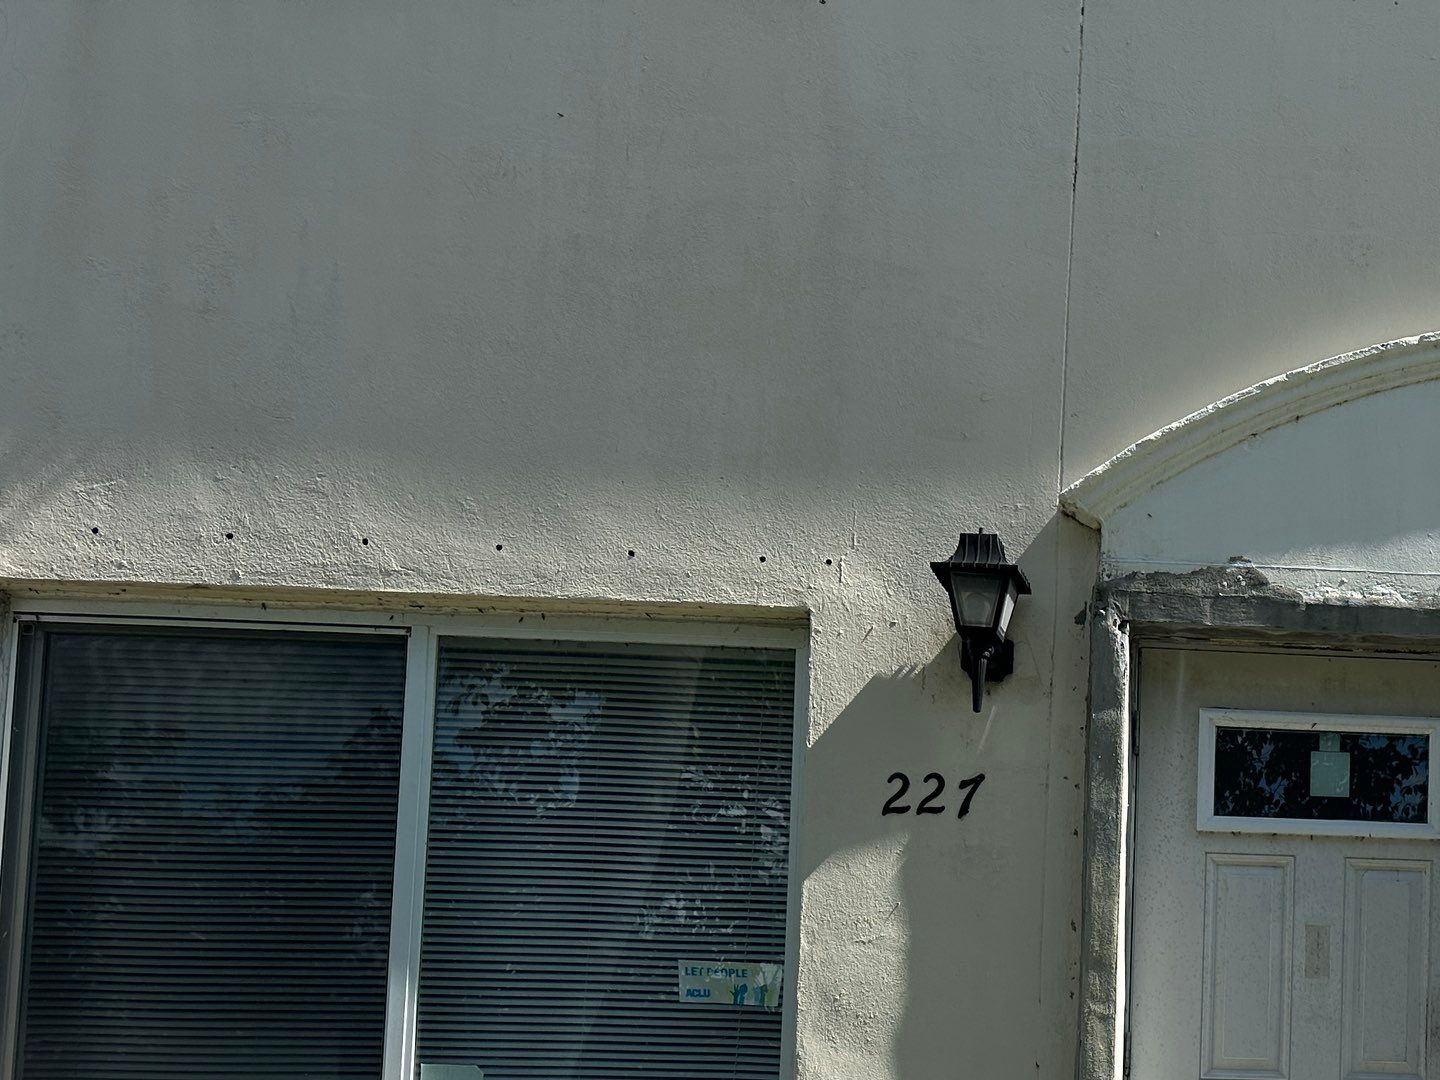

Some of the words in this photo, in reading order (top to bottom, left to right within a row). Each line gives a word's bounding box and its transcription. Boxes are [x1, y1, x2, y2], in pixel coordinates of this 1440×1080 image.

[882, 771, 985, 819] 227
[684, 966, 704, 977] LET
[685, 988, 711, 998] ACLU
